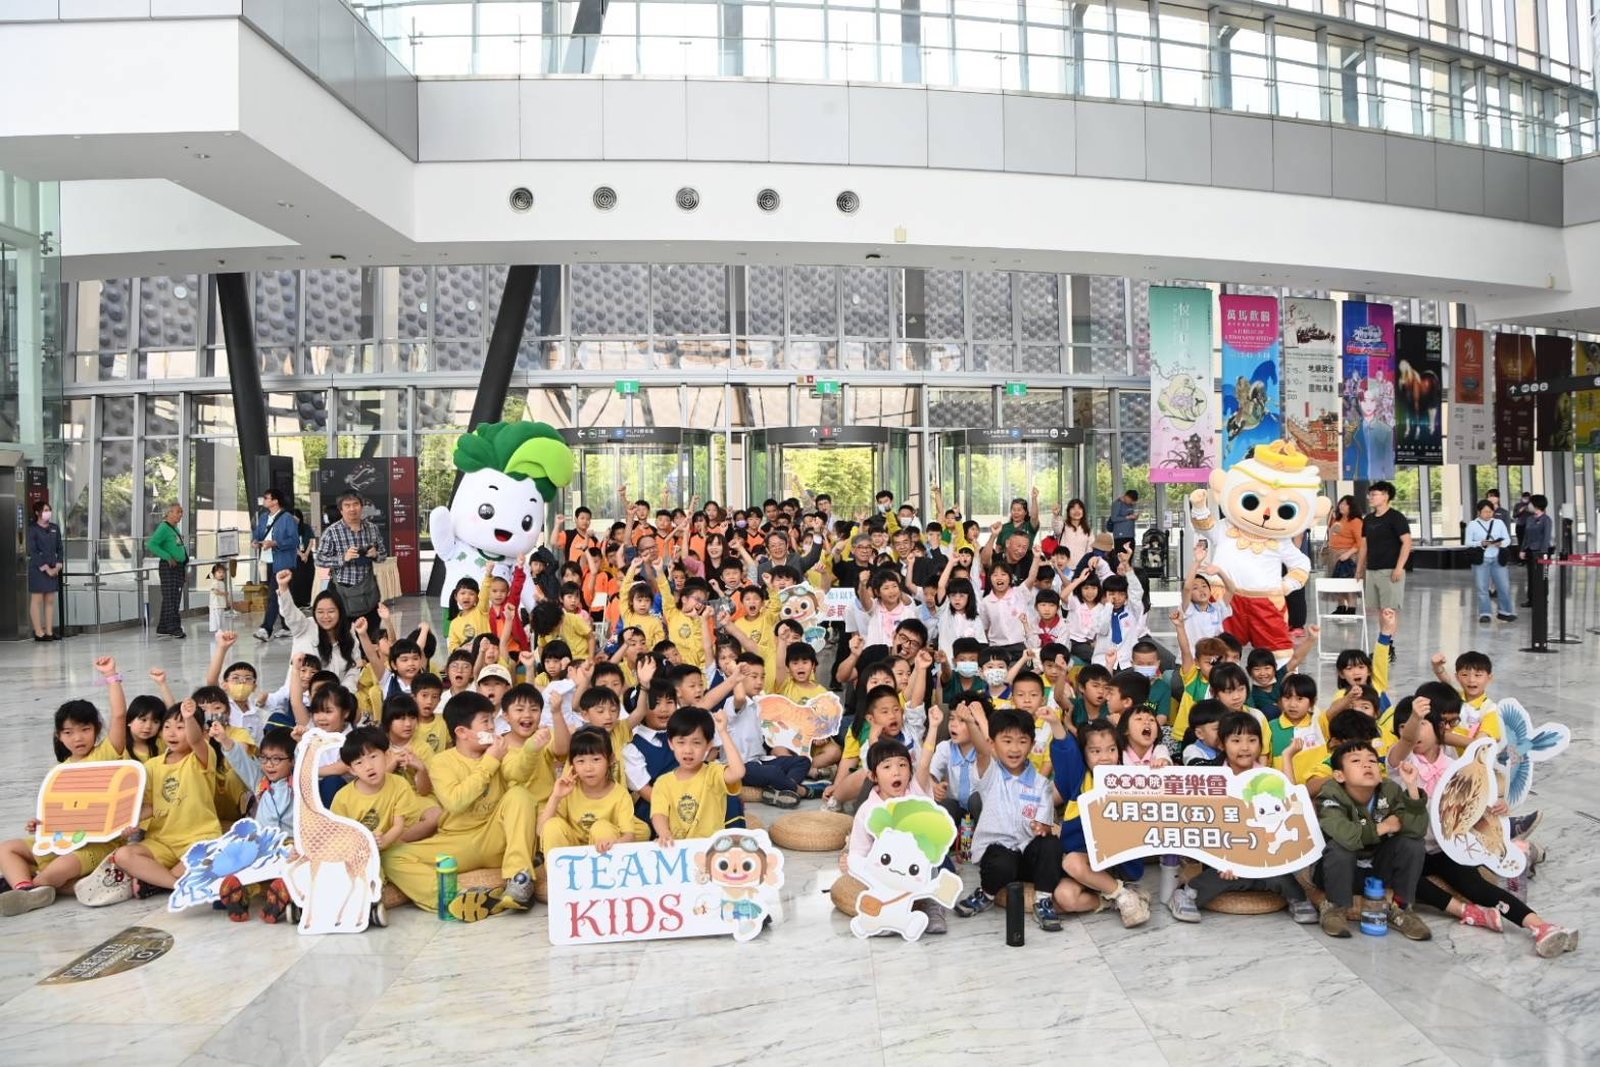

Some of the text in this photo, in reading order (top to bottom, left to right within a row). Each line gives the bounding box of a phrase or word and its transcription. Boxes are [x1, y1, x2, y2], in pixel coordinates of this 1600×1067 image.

[1104, 774, 1227, 796] 故宮南院 童樂會
[1102, 801, 1240, 824] 4月3日(五) 至
[1144, 826, 1257, 849] 4月6日(一)
[555, 848, 692, 890] TEAM
[565, 893, 683, 938] KIDS
